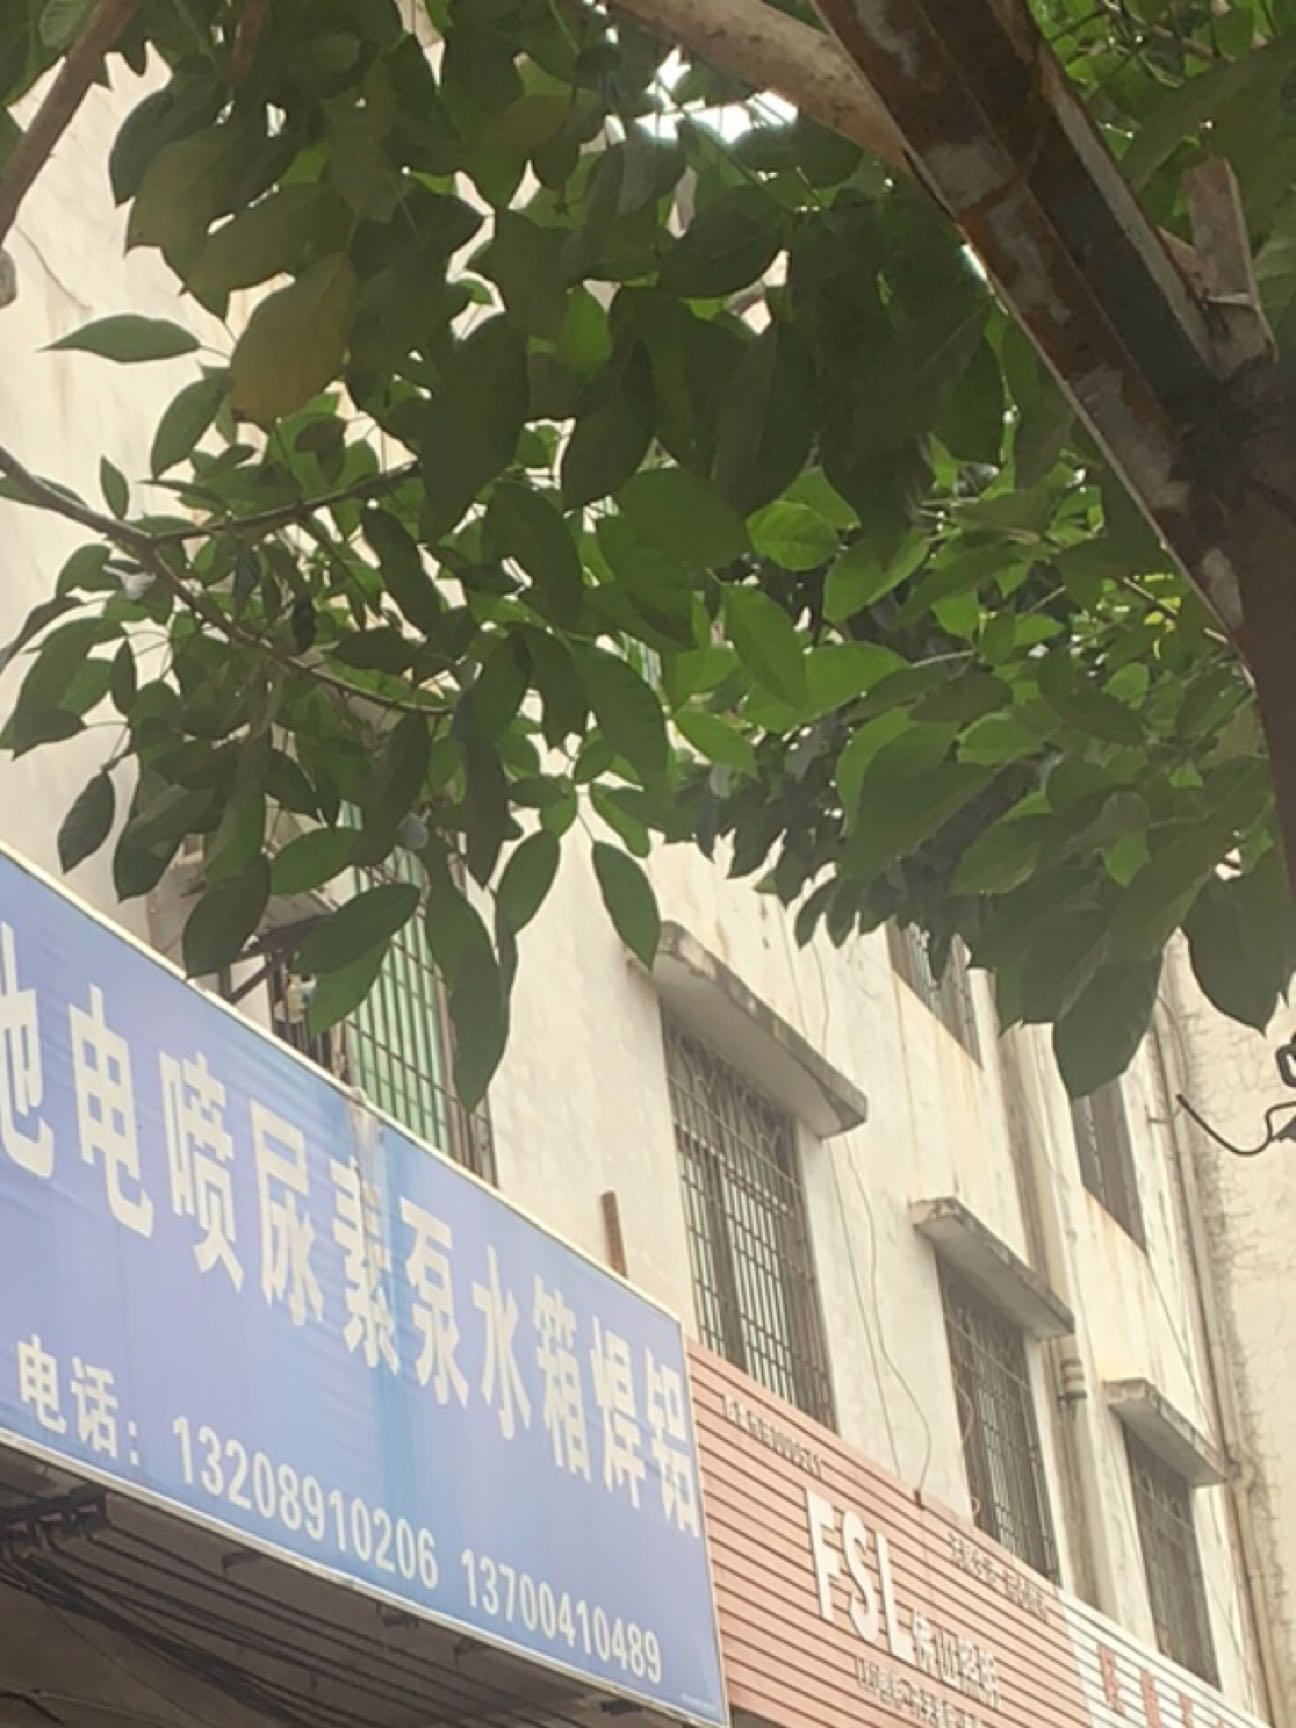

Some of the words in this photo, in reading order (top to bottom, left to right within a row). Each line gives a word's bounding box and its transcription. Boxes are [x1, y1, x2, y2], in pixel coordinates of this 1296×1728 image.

[172, 1416, 439, 1591] 13208910206
[461, 1548, 662, 1686] 13700410489
[805, 1488, 916, 1665] FSL
